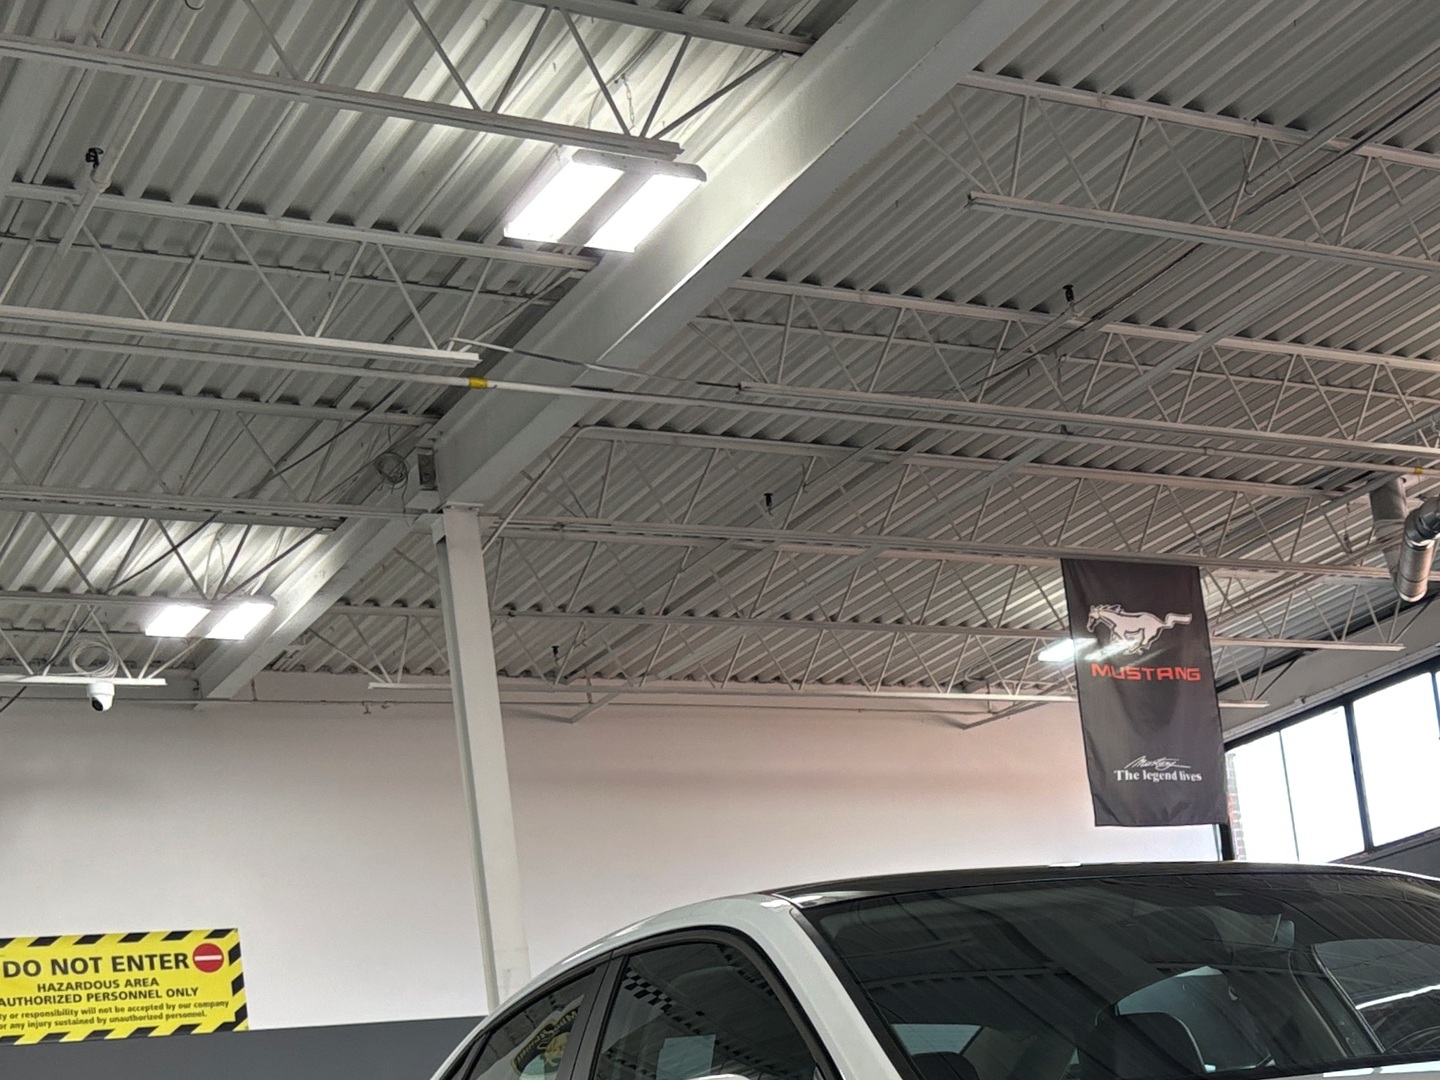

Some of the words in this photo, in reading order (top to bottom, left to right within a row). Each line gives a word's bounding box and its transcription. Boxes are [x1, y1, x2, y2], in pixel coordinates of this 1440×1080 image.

[1091, 663, 1202, 681] MUSTANG
[1114, 770, 1140, 781] The
[1142, 770, 1178, 782] legend
[1179, 771, 1203, 782] lives
[3, 959, 42, 978] DO
[51, 957, 103, 976] NOT
[112, 952, 190, 973] ENTER
[37, 979, 120, 993] HAZARDOUS
[124, 977, 160, 988] AREA
[0, 994, 82, 1007] AUTHORIZED
[86, 989, 163, 1002] PERSONNEL
[166, 987, 199, 998] ONLY
[21, 1008, 79, 1019] responsibility
[81, 1007, 96, 1015] will
[98, 1006, 112, 1014] not
[114, 1005, 125, 1013] be
[127, 1003, 164, 1012] accepted
[166, 1003, 176, 1011] by
[193, 1000, 230, 1009] company
[10, 1022, 25, 1030] any
[28, 1020, 52, 1029] injury
[54, 1016, 94, 1026] sustained
[97, 1016, 107, 1025] by
[109, 1012, 163, 1022] unauthorized
